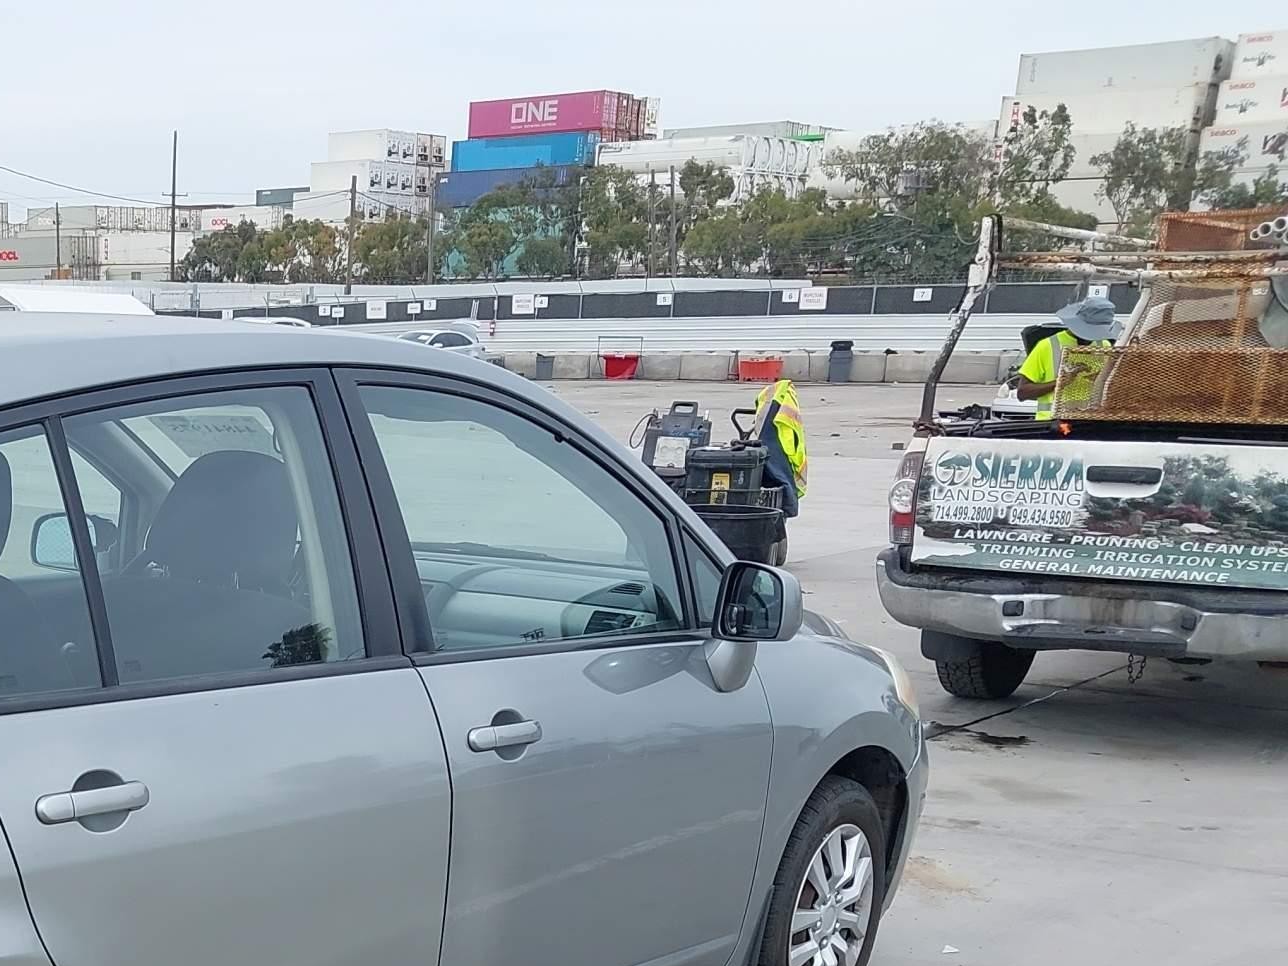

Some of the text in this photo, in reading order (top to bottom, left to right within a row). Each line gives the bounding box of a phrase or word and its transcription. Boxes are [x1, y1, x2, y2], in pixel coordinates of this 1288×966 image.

[511, 100, 559, 124] ONE
[972, 451, 1084, 492] SIERRA
[932, 488, 1082, 507] LANDSCAPING
[935, 505, 1073, 527] 714.499.2800 949.434.9580
[953, 528, 1054, 544] LAWNCARE
[1070, 534, 1160, 551] PRUNING
[1180, 541, 1244, 555] CLEAN
[1250, 545, 1288, 558] UPS
[980, 543, 1076, 559] TRIMMING
[1094, 550, 1216, 568] IRRIGATION
[1220, 558, 1288, 573] SYSTE
[999, 558, 1231, 584] GENERAL MAINTENANCE
